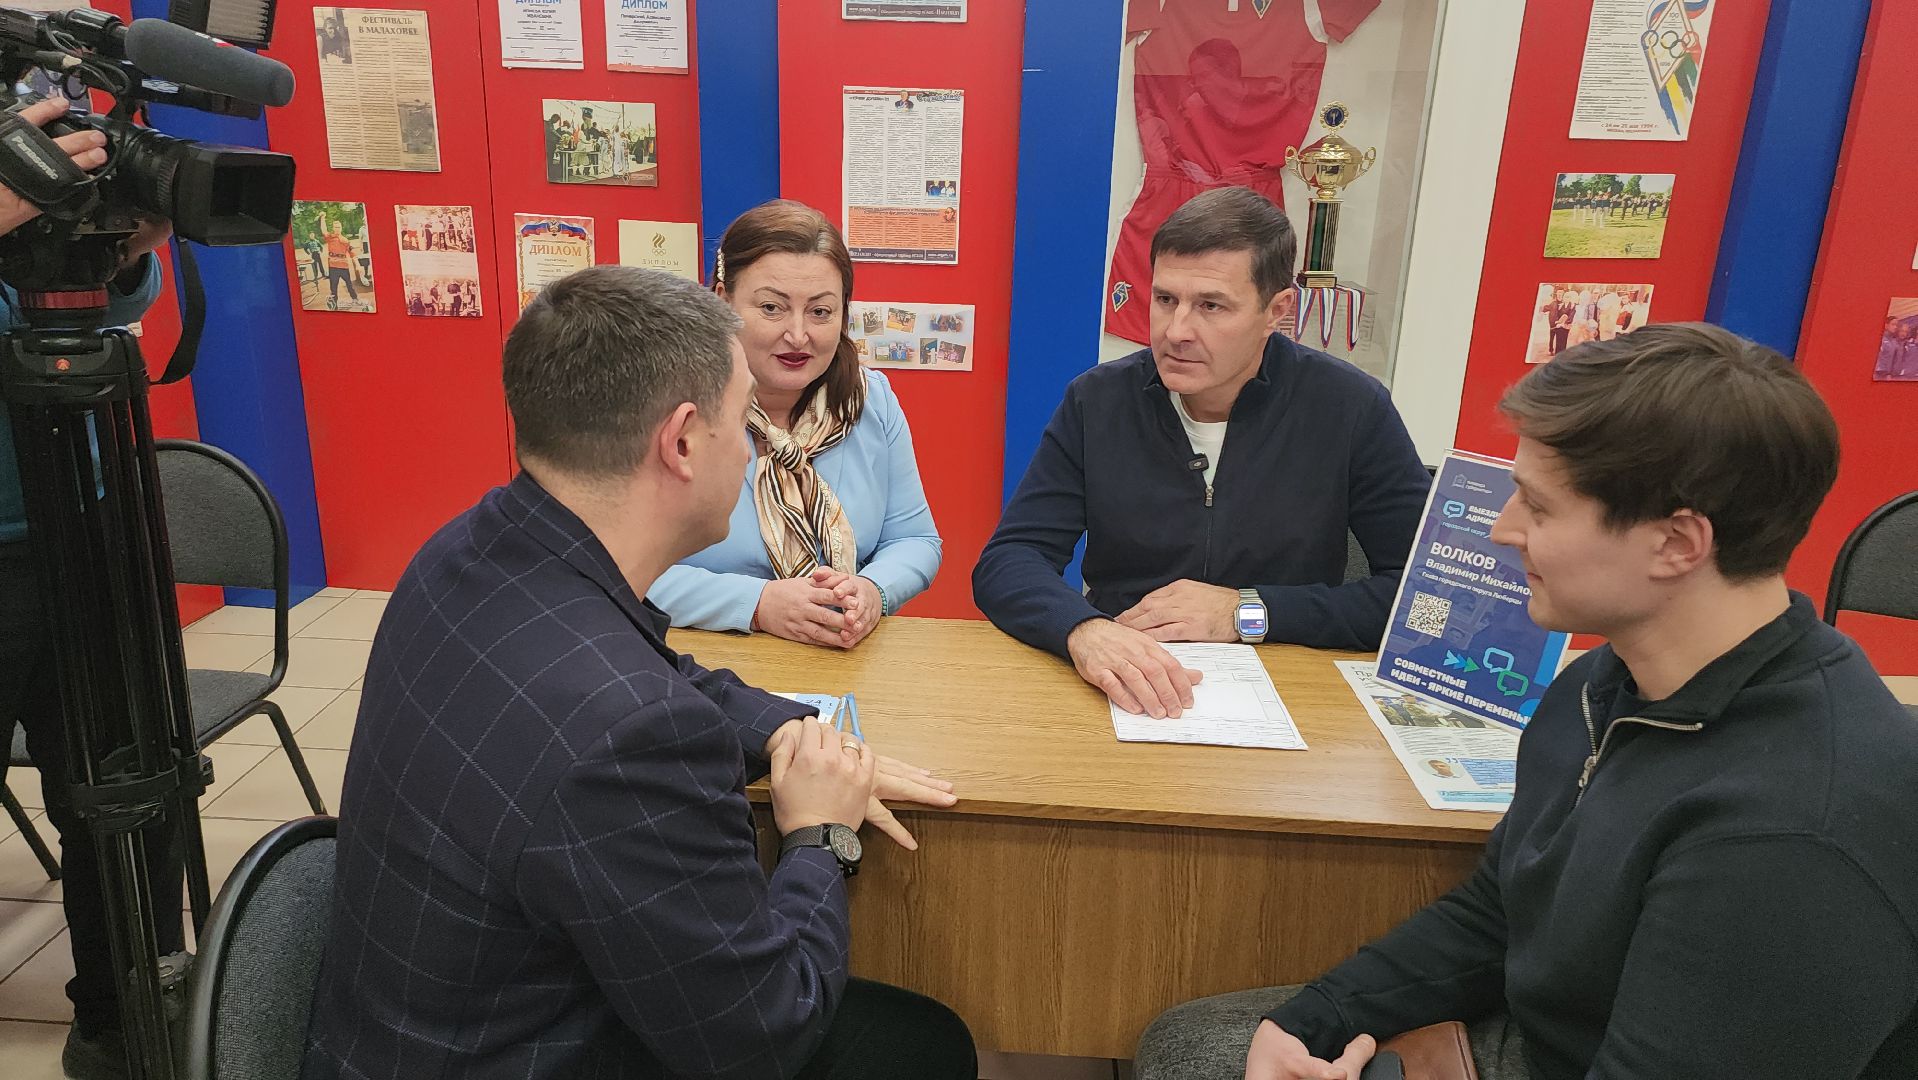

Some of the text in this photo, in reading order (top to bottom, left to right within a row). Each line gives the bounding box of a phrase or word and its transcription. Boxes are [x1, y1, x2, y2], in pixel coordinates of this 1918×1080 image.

[361, 15, 413, 25] ФЕСТИВАЛЬ
[366, 27, 419, 35] МАЛАХОВКЕ
[11, 135, 58, 180] Panasonic
[529, 244, 582, 257] ДИПЛОМ
[1425, 558, 1480, 582] Владимир
[1430, 541, 1497, 570] ВОЛКОВ
[1421, 571, 1523, 606] Глава городского округа Люберцы
[1390, 668, 1422, 687] ИДЕИ
[1427, 682, 1464, 702] ЯРКИЕ
[1393, 656, 1468, 690] СОВМЕСТНЫЕ
